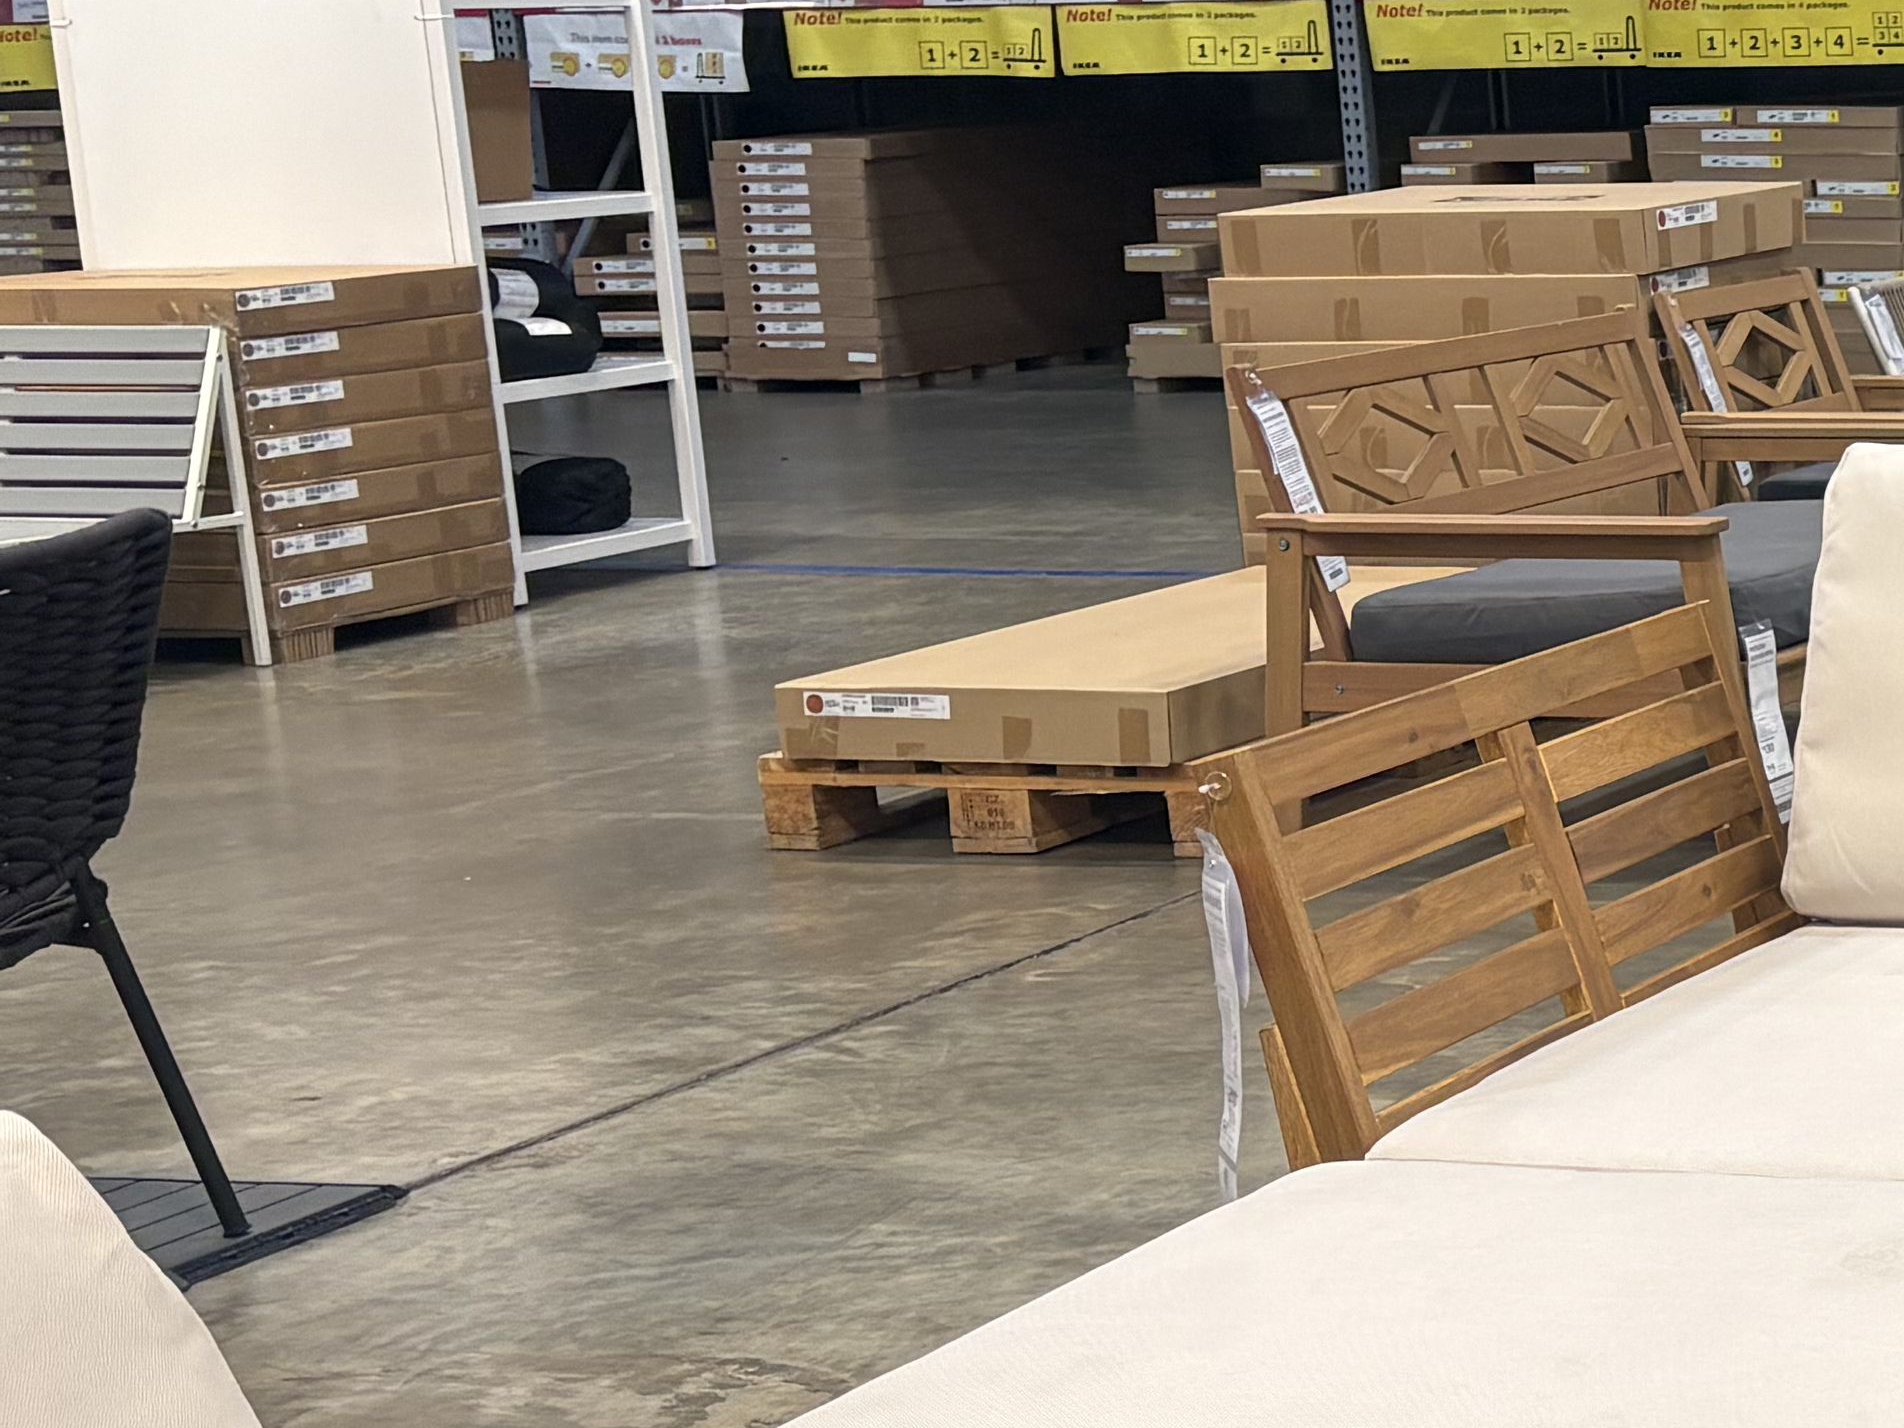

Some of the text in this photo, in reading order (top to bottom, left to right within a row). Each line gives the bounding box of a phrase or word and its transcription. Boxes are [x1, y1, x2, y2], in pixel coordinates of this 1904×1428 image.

[1066, 8, 1112, 23] Note!
[1376, 3, 1425, 18] Note!
[794, 11, 842, 26] Note!
[0, 27, 37, 42] ote!
[1512, 39, 1565, 55] 1 2
[1706, 35, 1845, 50] 1 2 3 4
[927, 48, 980, 62] 1 2
[1198, 44, 1250, 57] 1 2
